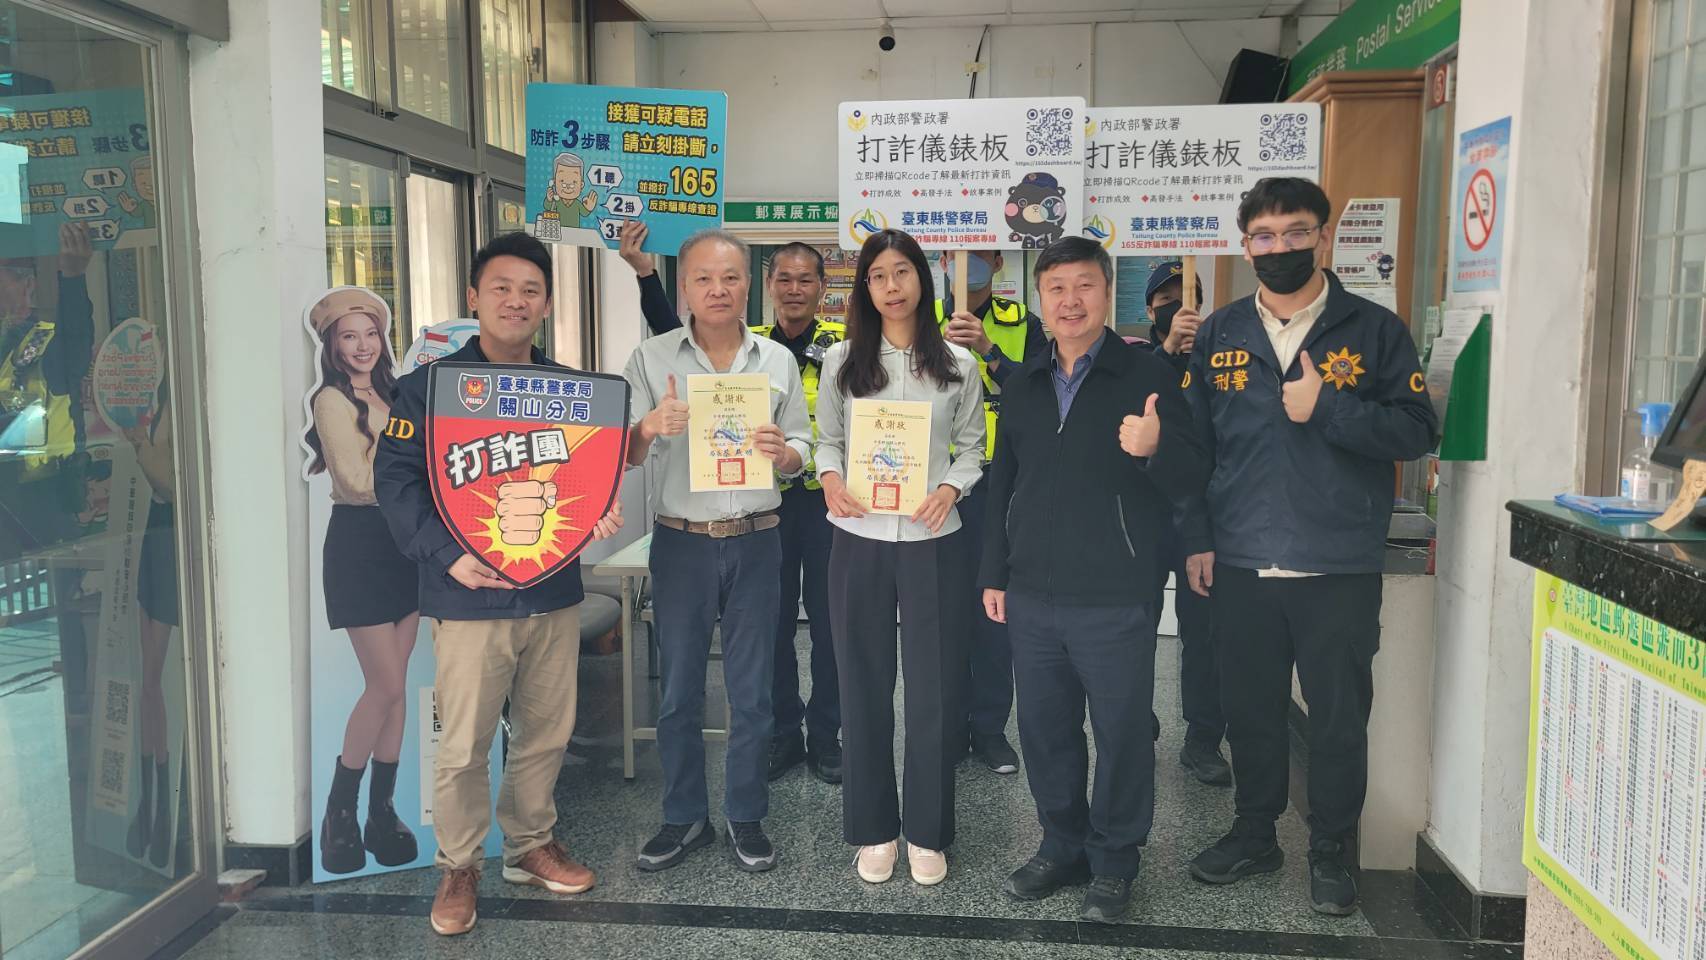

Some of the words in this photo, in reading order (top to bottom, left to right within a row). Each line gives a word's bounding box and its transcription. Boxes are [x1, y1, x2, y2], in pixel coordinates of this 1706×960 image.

[1356, 15, 1390, 64] Postal
[607, 102, 708, 128] 接獲可疑電話
[870, 111, 950, 126] 內政部警政署
[1101, 117, 1181, 132] 內政部警政署
[530, 120, 610, 151] 防詐3步驟
[856, 133, 1010, 164] 打詐儀錶板
[1085, 138, 1242, 169] 打詐儀錶板
[638, 181, 668, 195] 並撥打
[670, 166, 717, 197] 165
[855, 169, 1011, 181] 立即掃描QRcode了解最新打詐資訊
[1083, 175, 1244, 187] 立即掃描QRcode了解最新打詐資訊
[869, 189, 902, 198] 打詐成效
[920, 188, 953, 198] 高發手法
[969, 187, 1002, 197] 故事案例
[1097, 195, 1131, 204] 打詐成效
[1149, 194, 1184, 203] 高發手法
[1200, 193, 1235, 202] 故事案例
[613, 196, 635, 213] 2掛
[648, 199, 718, 217] 反詐騙專線查證
[901, 210, 988, 226] 臺東縣警察局
[1130, 216, 1219, 232] 臺東縣警察局
[1155, 232, 1176, 240] County
[1210, 350, 1250, 369] CID
[497, 375, 593, 398] 臺東縣警察局
[1213, 369, 1249, 392] 刑警
[497, 396, 591, 422] 關山分局
[446, 429, 569, 488] 打詐團
